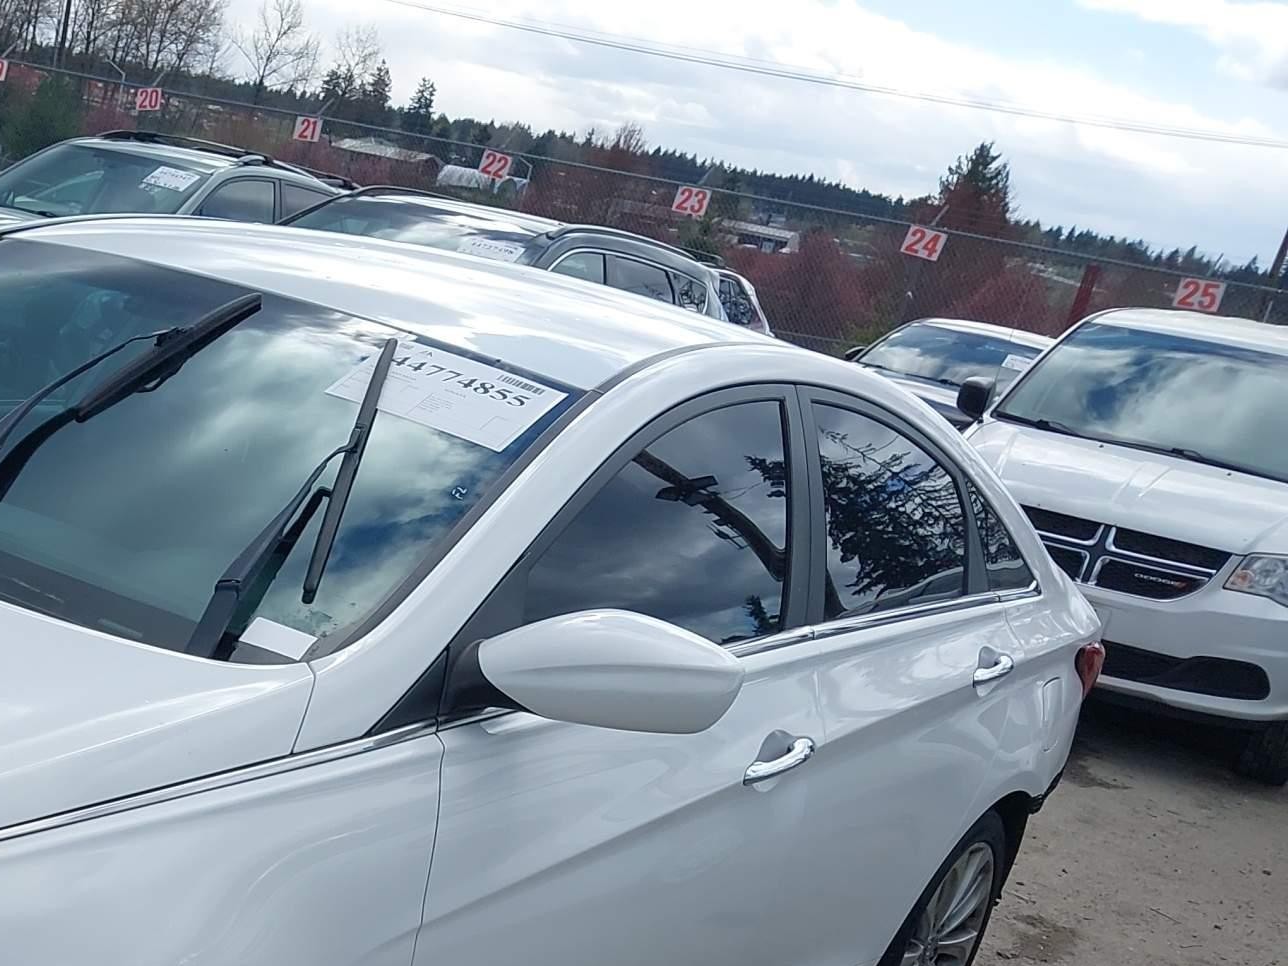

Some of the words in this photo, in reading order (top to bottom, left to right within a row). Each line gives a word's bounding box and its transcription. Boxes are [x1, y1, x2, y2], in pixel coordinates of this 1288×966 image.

[138, 89, 160, 110] 20
[298, 118, 317, 140] 21
[480, 152, 509, 179] 22
[674, 188, 707, 214] 23
[903, 228, 942, 258] 24
[1176, 280, 1221, 310] 25
[391, 356, 532, 408] 44774855
